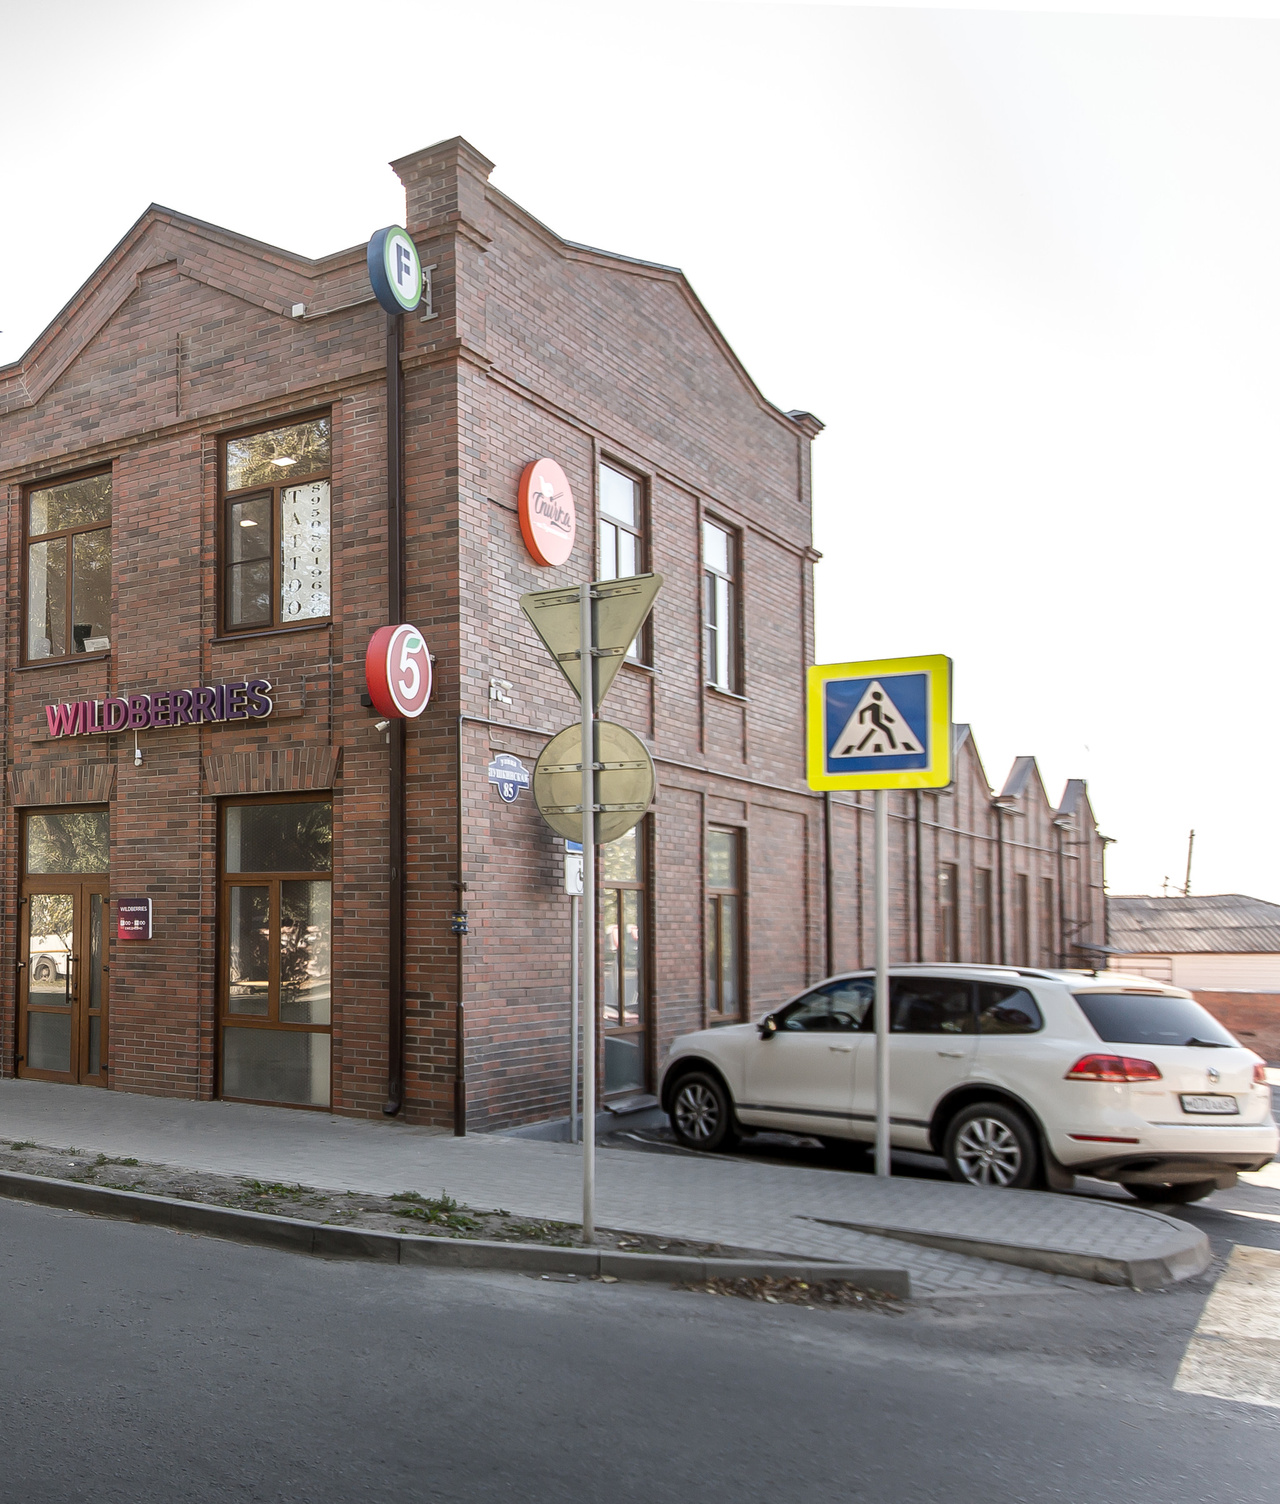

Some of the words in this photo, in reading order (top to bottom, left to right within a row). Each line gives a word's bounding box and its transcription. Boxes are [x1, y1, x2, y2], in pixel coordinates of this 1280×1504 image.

[396, 243, 410, 286] F
[288, 489, 302, 616] TATTOO
[45, 679, 273, 738] WILDBERRIES
[504, 783, 514, 797] 85
